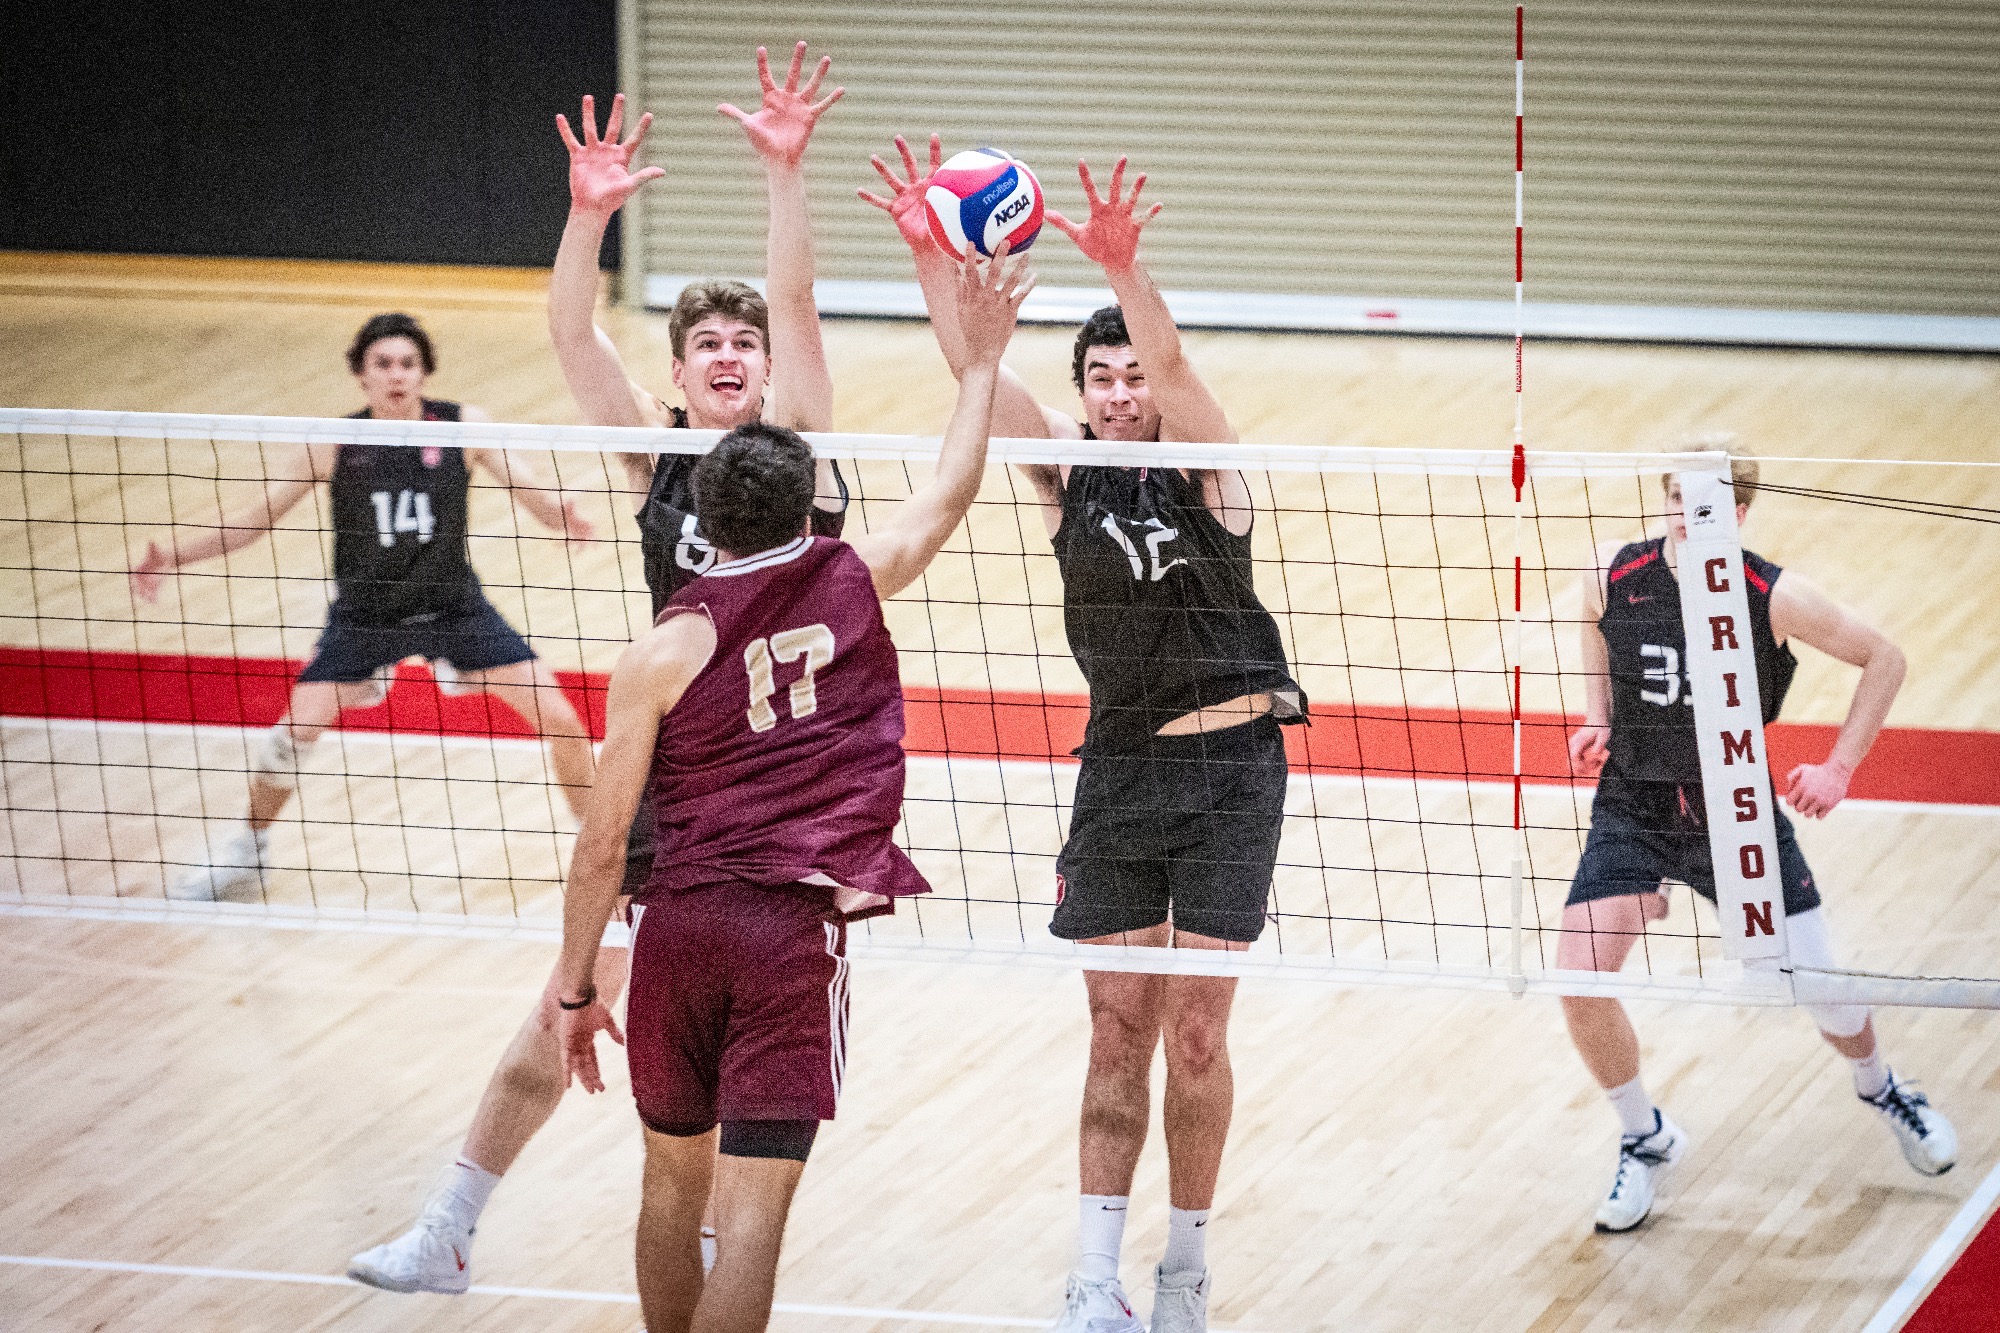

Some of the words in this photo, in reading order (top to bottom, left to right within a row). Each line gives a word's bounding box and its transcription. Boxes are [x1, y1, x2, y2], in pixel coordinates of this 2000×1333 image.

[982, 177, 1016, 206] molten
[994, 193, 1031, 228] NCAA
[370, 489, 436, 547] 14
[743, 623, 835, 733] 17
[1640, 643, 1695, 707] 3
[1704, 557, 1776, 938] CRIMSON
